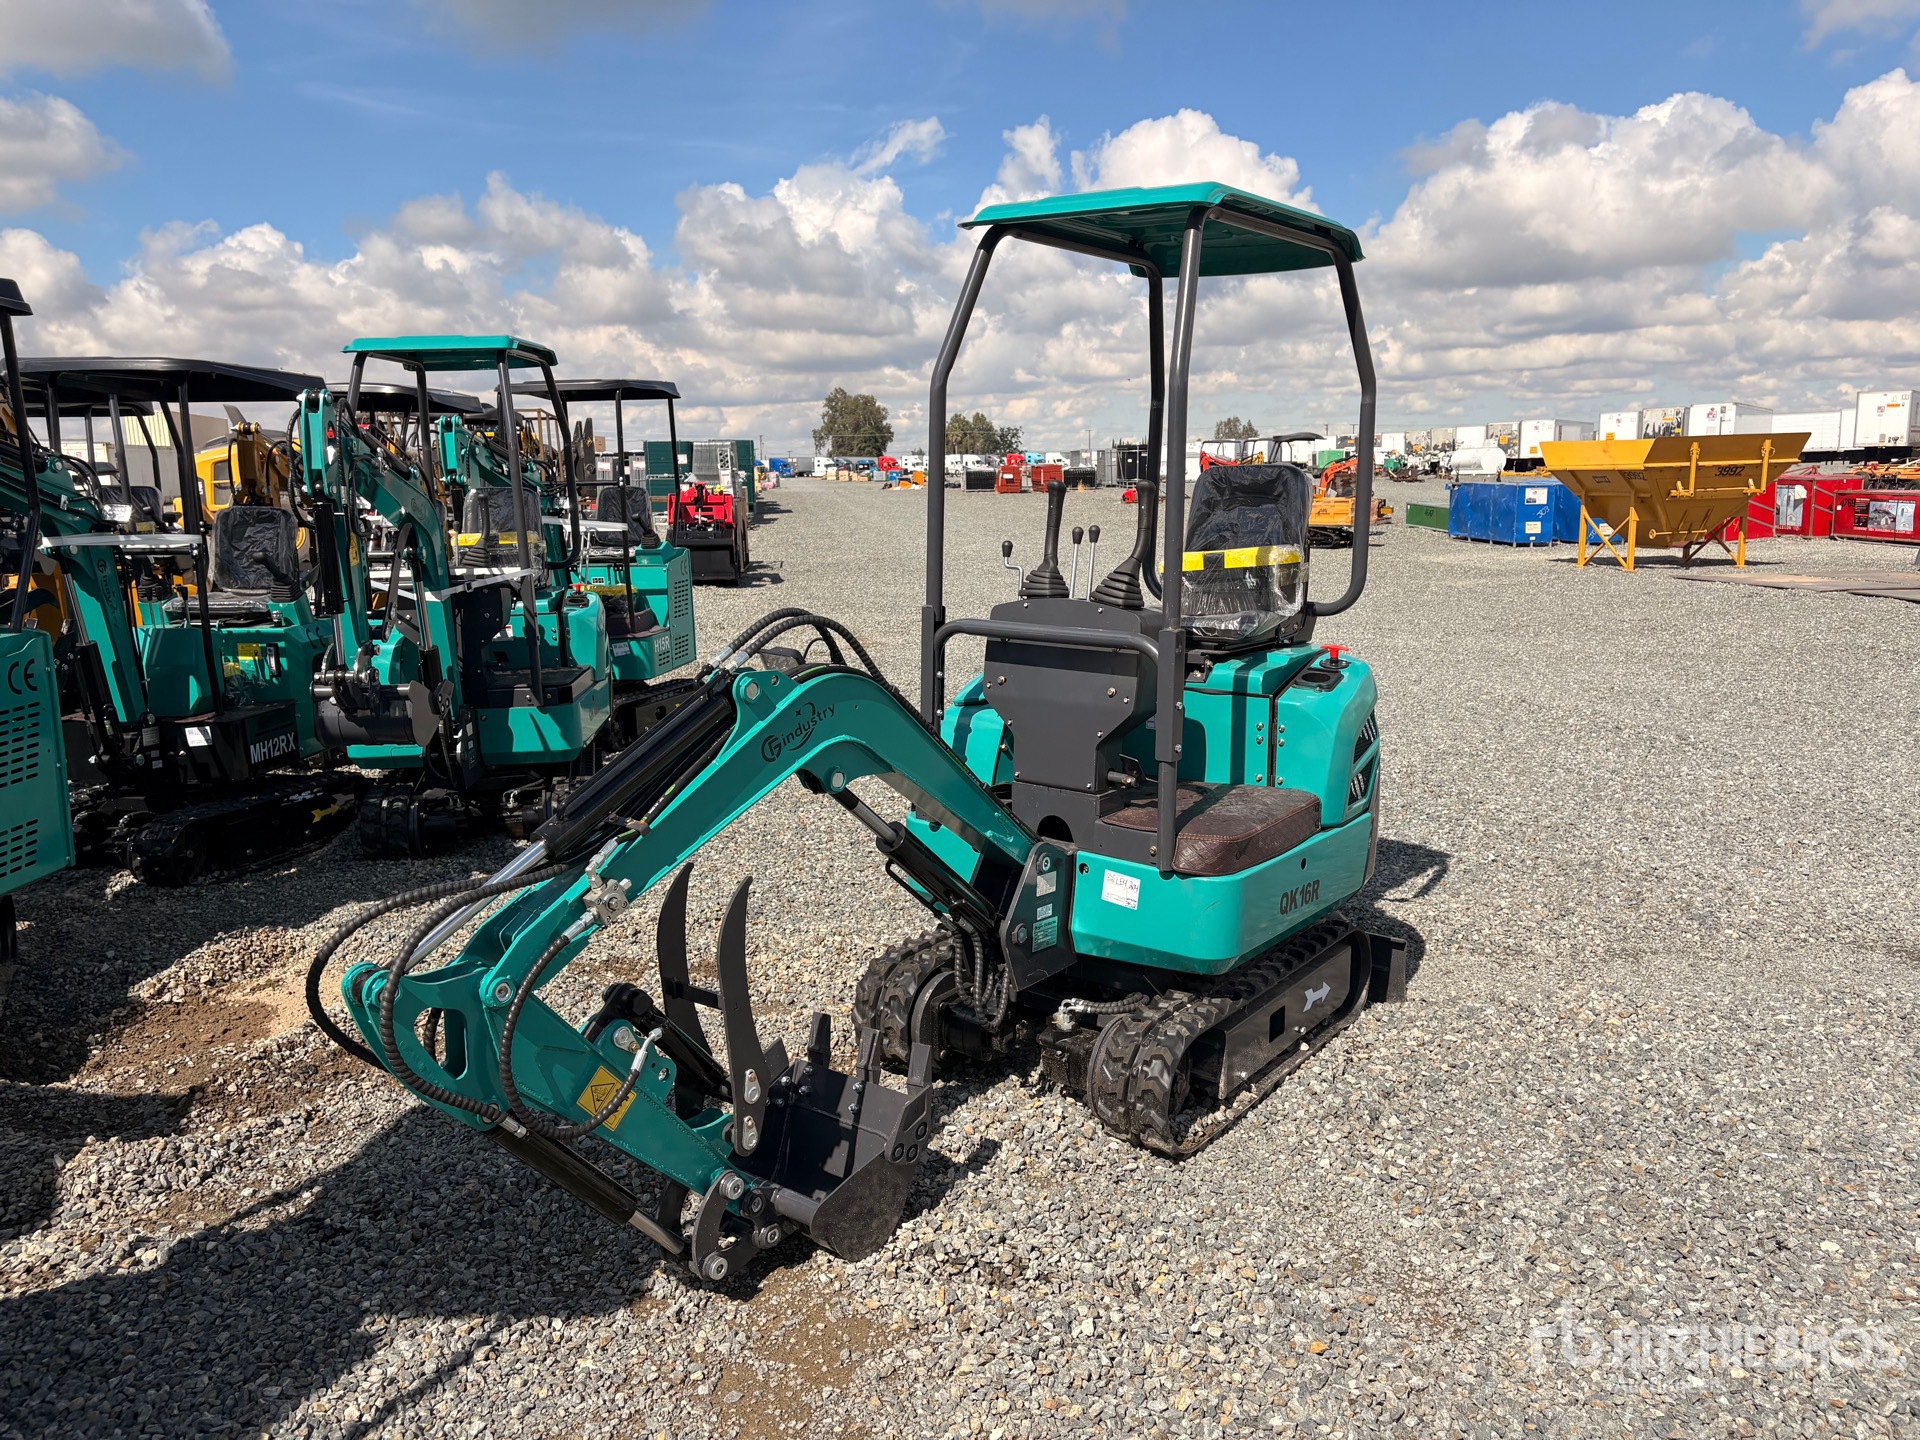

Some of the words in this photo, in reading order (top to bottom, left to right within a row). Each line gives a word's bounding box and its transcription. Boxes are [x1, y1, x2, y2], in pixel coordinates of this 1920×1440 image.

[1715, 466, 1745, 477] 3992
[7, 658, 38, 695] CE
[249, 731, 296, 765] MH12RX
